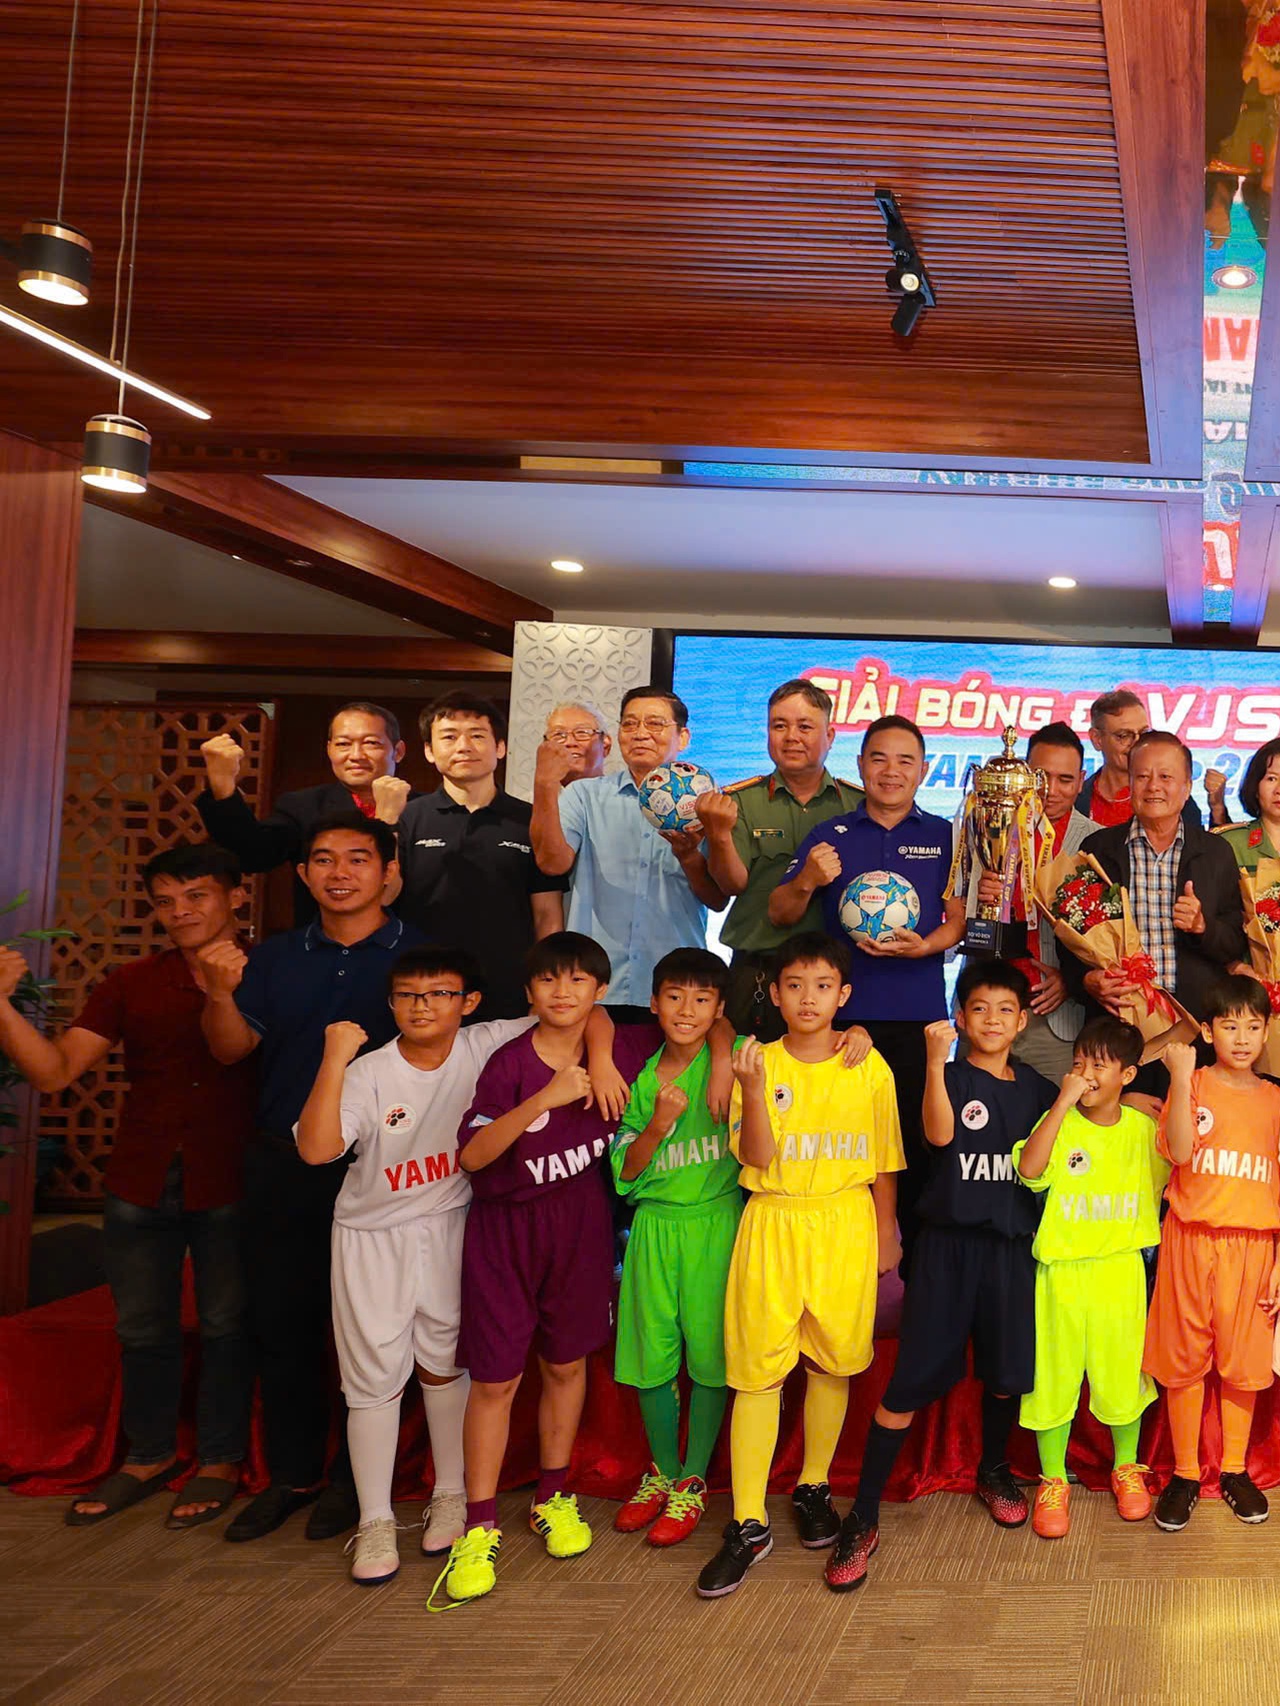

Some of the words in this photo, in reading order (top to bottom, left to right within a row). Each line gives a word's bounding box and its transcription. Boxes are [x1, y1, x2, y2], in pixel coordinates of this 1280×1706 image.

[916, 679, 1055, 730] BÓNG
[908, 846, 941, 855] YAMAHA
[525, 1133, 615, 1185] YAMA
[655, 1132, 729, 1173] AMAH
[781, 1133, 869, 1161] AMAHA
[384, 1149, 459, 1192] YAM
[959, 1153, 1019, 1183] YAM
[1192, 1148, 1272, 1184] YAMAH
[1060, 1193, 1138, 1222] YAMH
